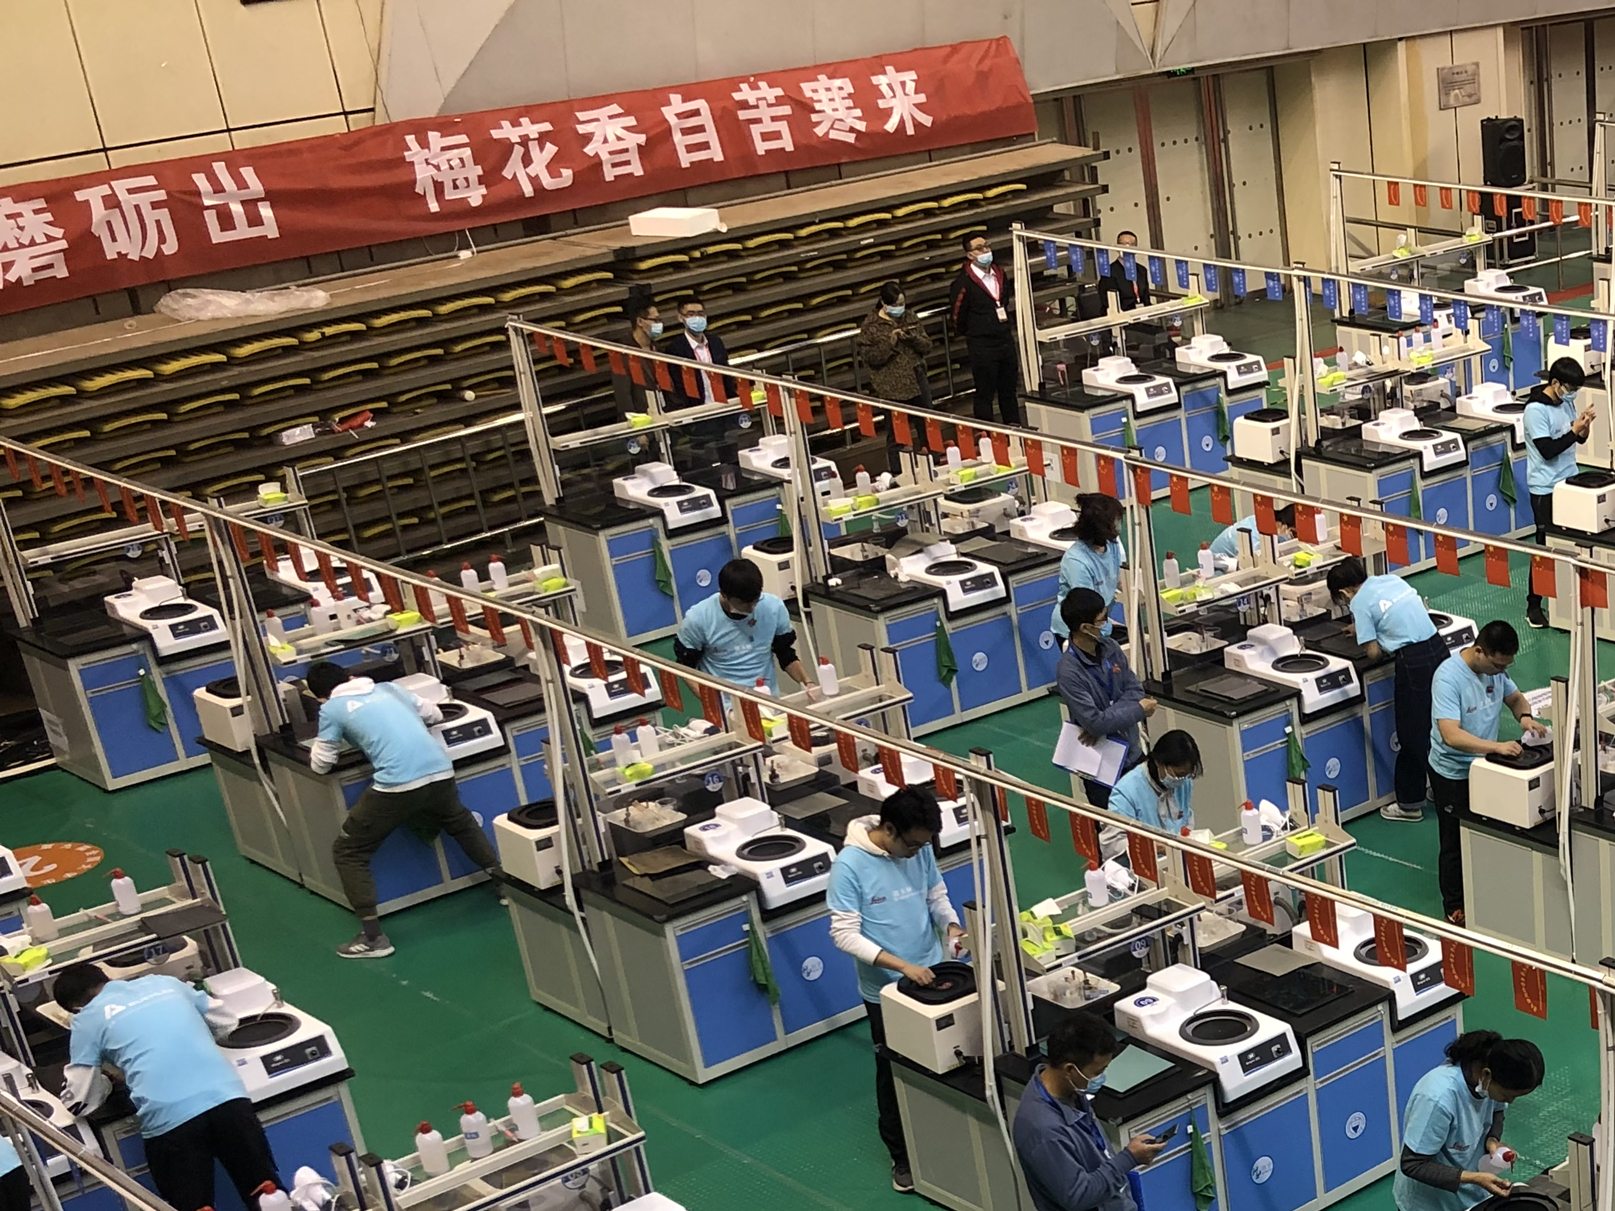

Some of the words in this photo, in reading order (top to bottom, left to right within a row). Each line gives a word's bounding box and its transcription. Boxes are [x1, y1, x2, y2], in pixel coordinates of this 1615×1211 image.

[0, 161, 280, 289] 磨砺出
[404, 65, 934, 214] 梅花香自苦寒来
